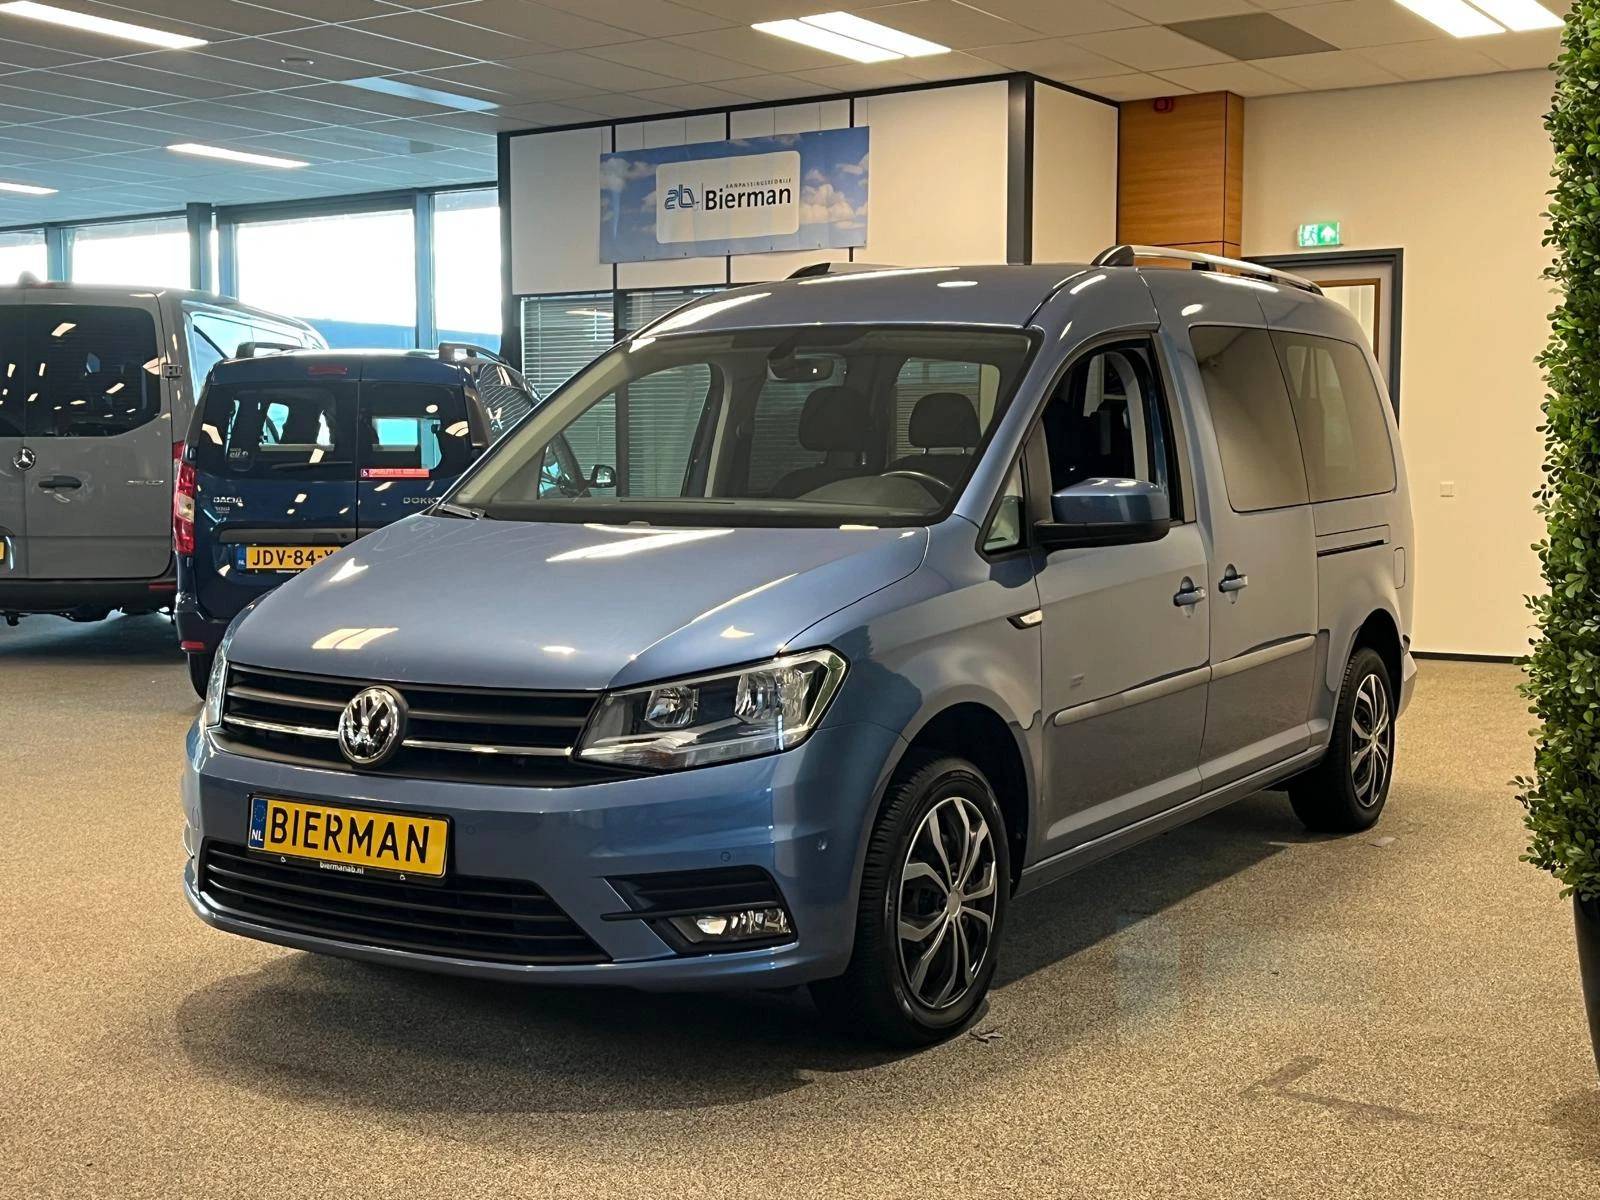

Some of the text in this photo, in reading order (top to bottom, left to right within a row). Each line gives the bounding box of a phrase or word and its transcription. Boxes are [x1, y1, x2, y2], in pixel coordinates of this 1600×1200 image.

[705, 187, 791, 211] Bierman
[251, 828, 264, 842] NL
[270, 806, 430, 864] BIERMAN
[319, 861, 365, 875] biermanab.nl
